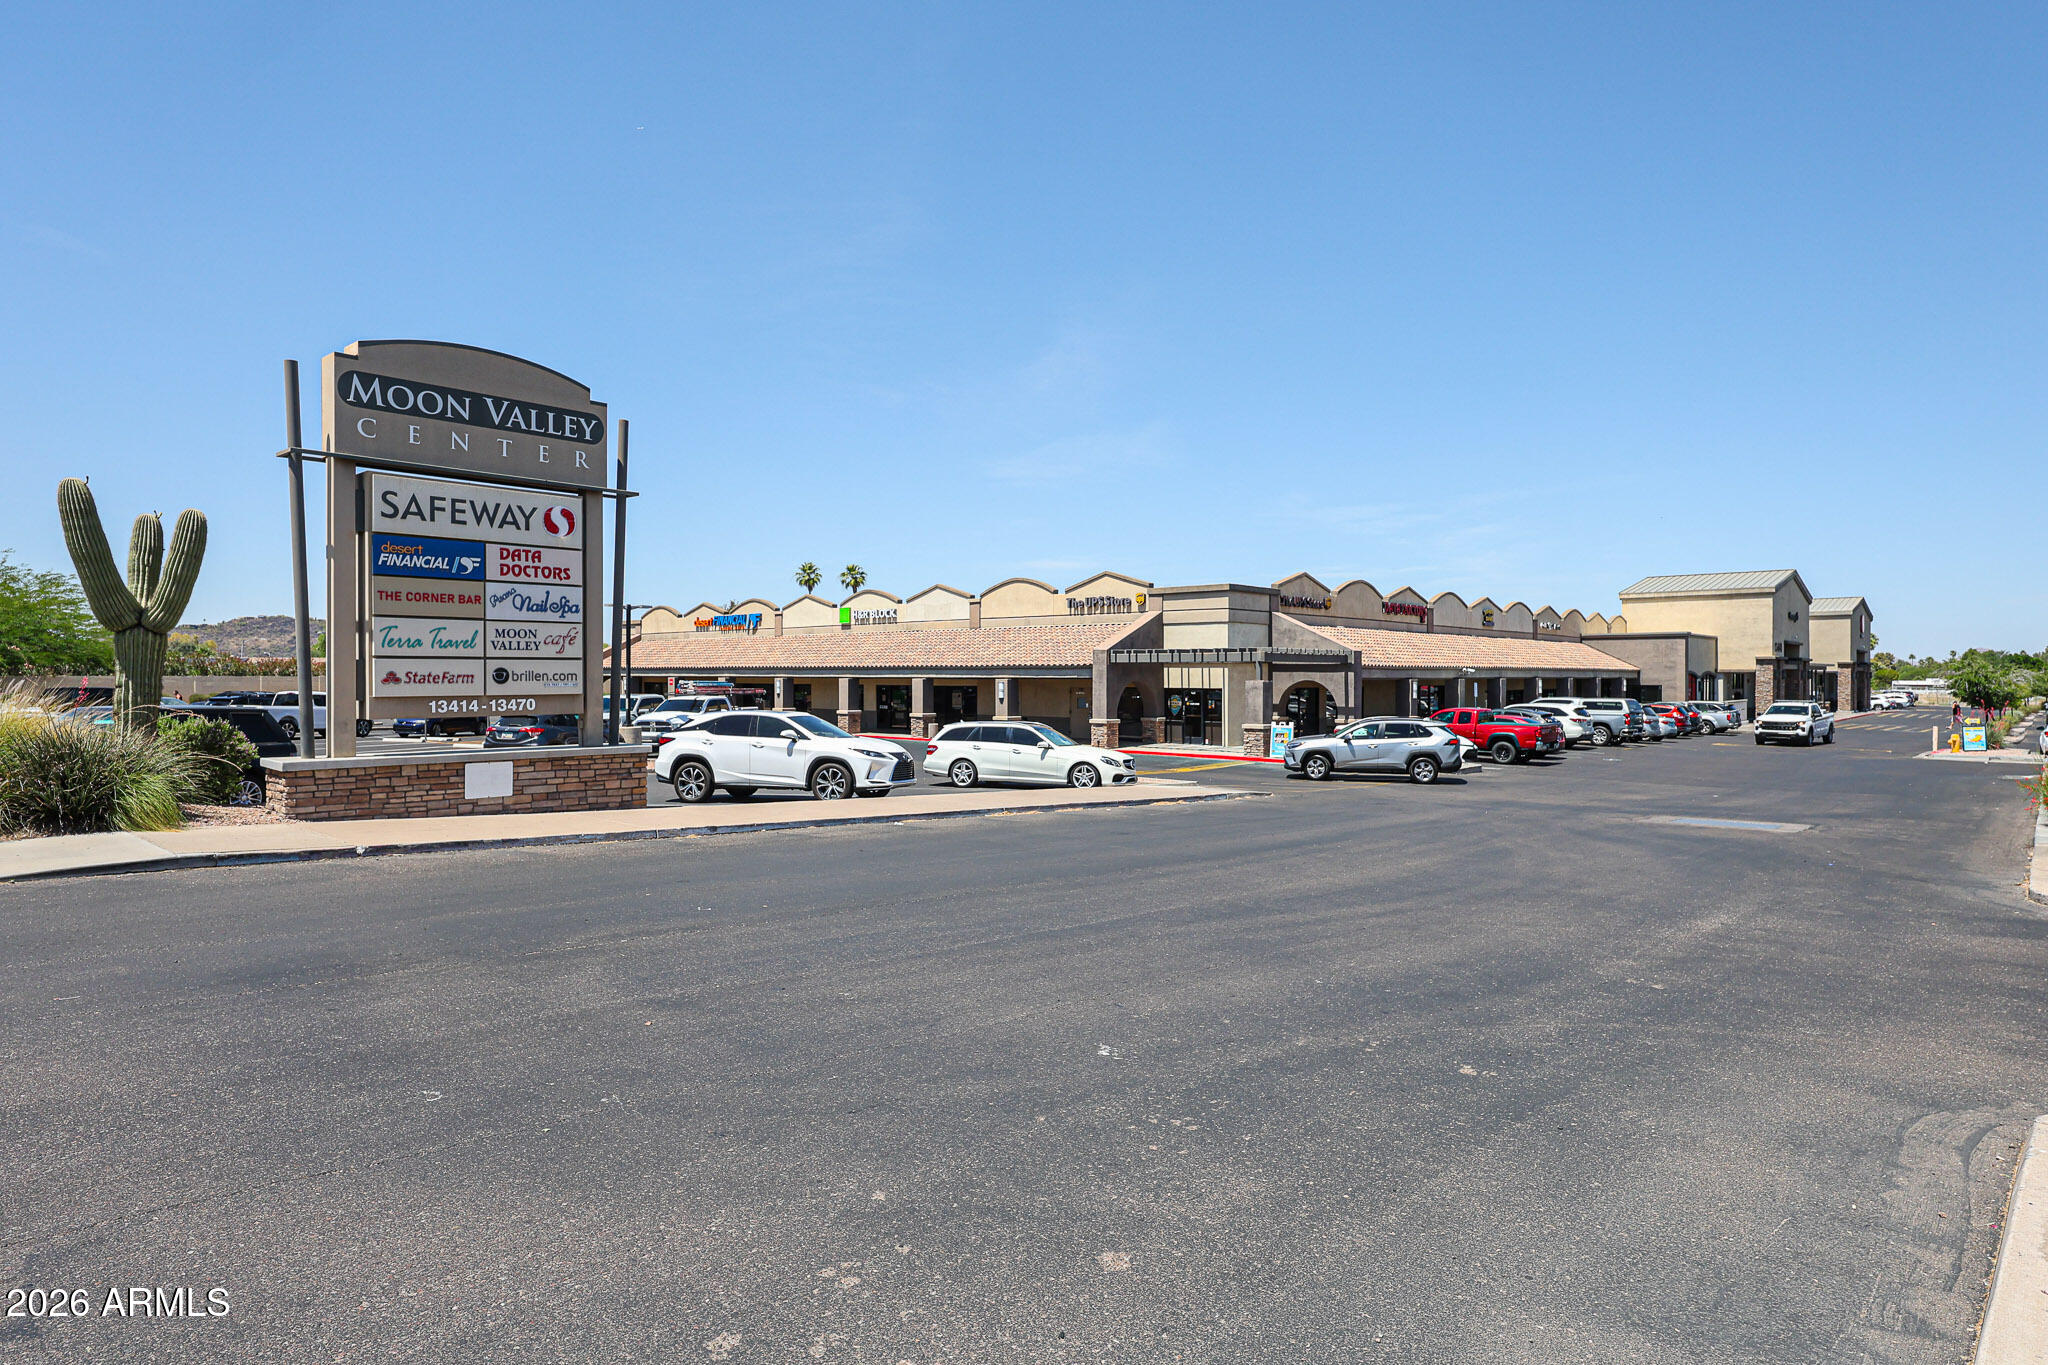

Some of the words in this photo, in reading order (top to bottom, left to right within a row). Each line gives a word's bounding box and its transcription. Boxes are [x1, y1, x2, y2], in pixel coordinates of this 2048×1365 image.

[347, 373, 470, 420] MOON
[483, 396, 598, 440] VALLEY
[357, 418, 590, 469] CENTER
[380, 491, 538, 531] SAFEWAY
[381, 540, 423, 554] desert
[499, 547, 542, 563] DATA
[378, 553, 449, 569] FINANCIAL
[499, 563, 571, 581] DOCTORS
[377, 590, 402, 601] THE
[405, 592, 455, 604] CORNER
[458, 594, 482, 605] BAR
[512, 590, 549, 612] Nail
[549, 596, 580, 618] Spa
[1066, 597, 1084, 609] The
[1085, 595, 1104, 608] UPS
[1104, 595, 1131, 607] Store
[853, 610, 869, 619] H&R
[870, 608, 897, 618] BLOCK
[379, 625, 423, 648] Terra
[429, 626, 479, 649] Travel
[495, 628, 538, 639] MOON
[543, 626, 579, 654] café
[490, 640, 541, 651] VALLEY
[511, 670, 578, 682] brillen.com
